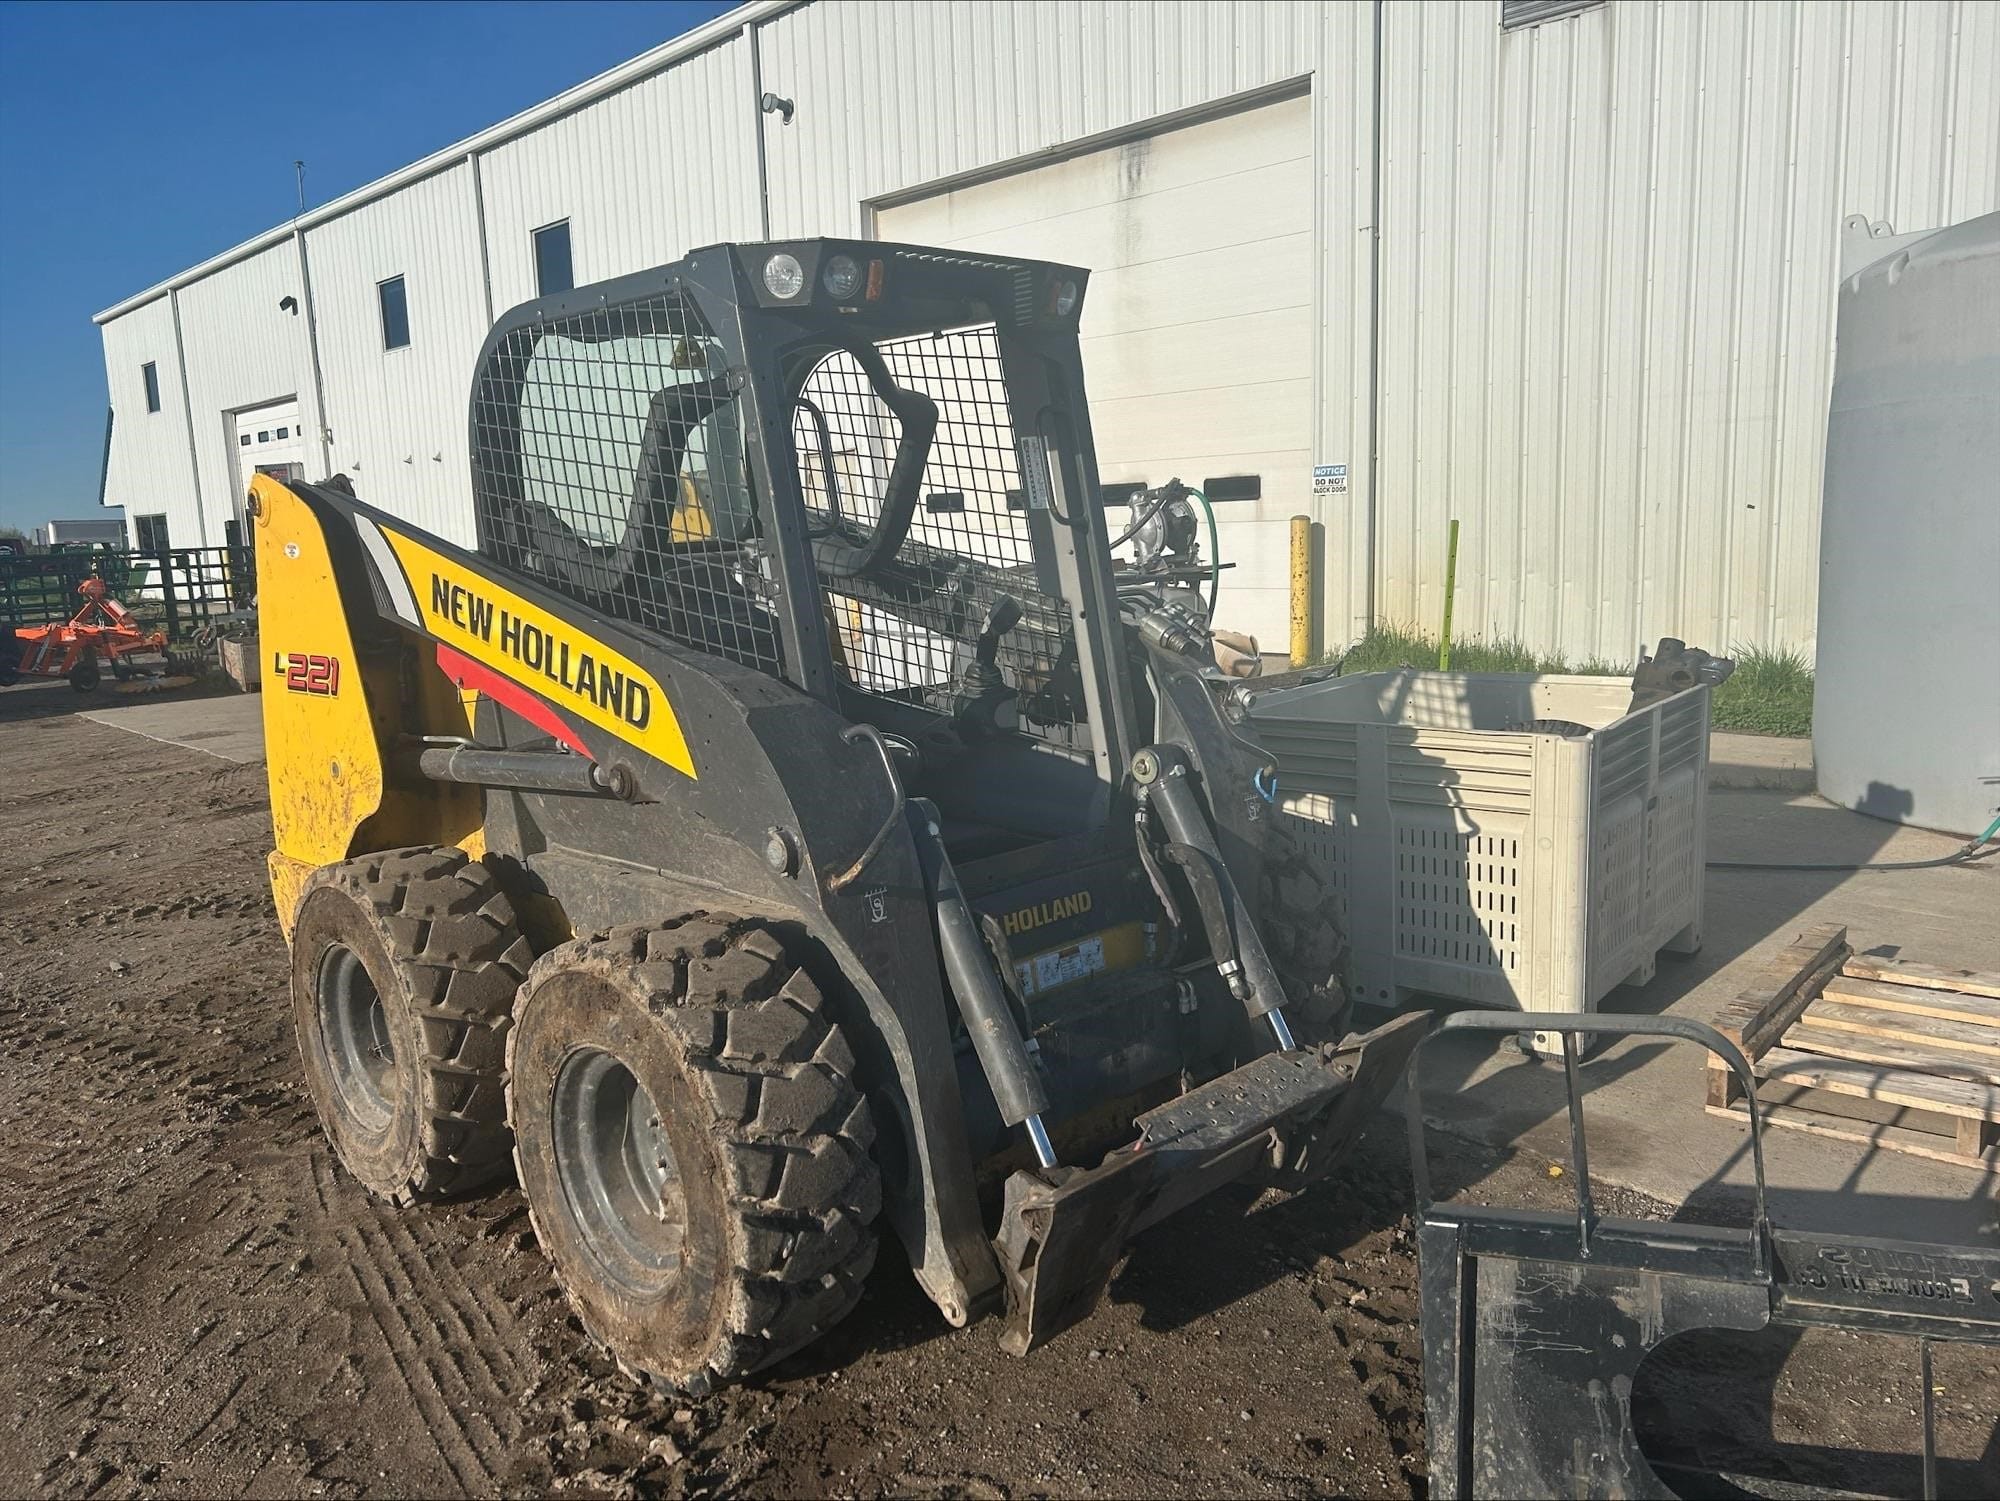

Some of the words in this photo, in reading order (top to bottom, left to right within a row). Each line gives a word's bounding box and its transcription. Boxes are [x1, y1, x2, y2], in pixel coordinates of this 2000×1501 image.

[1315, 467, 1345, 475] NOTICE
[432, 572, 493, 643] NEW
[500, 610, 651, 731] HOLLAND
[1003, 890, 1093, 936] HOLLAND
